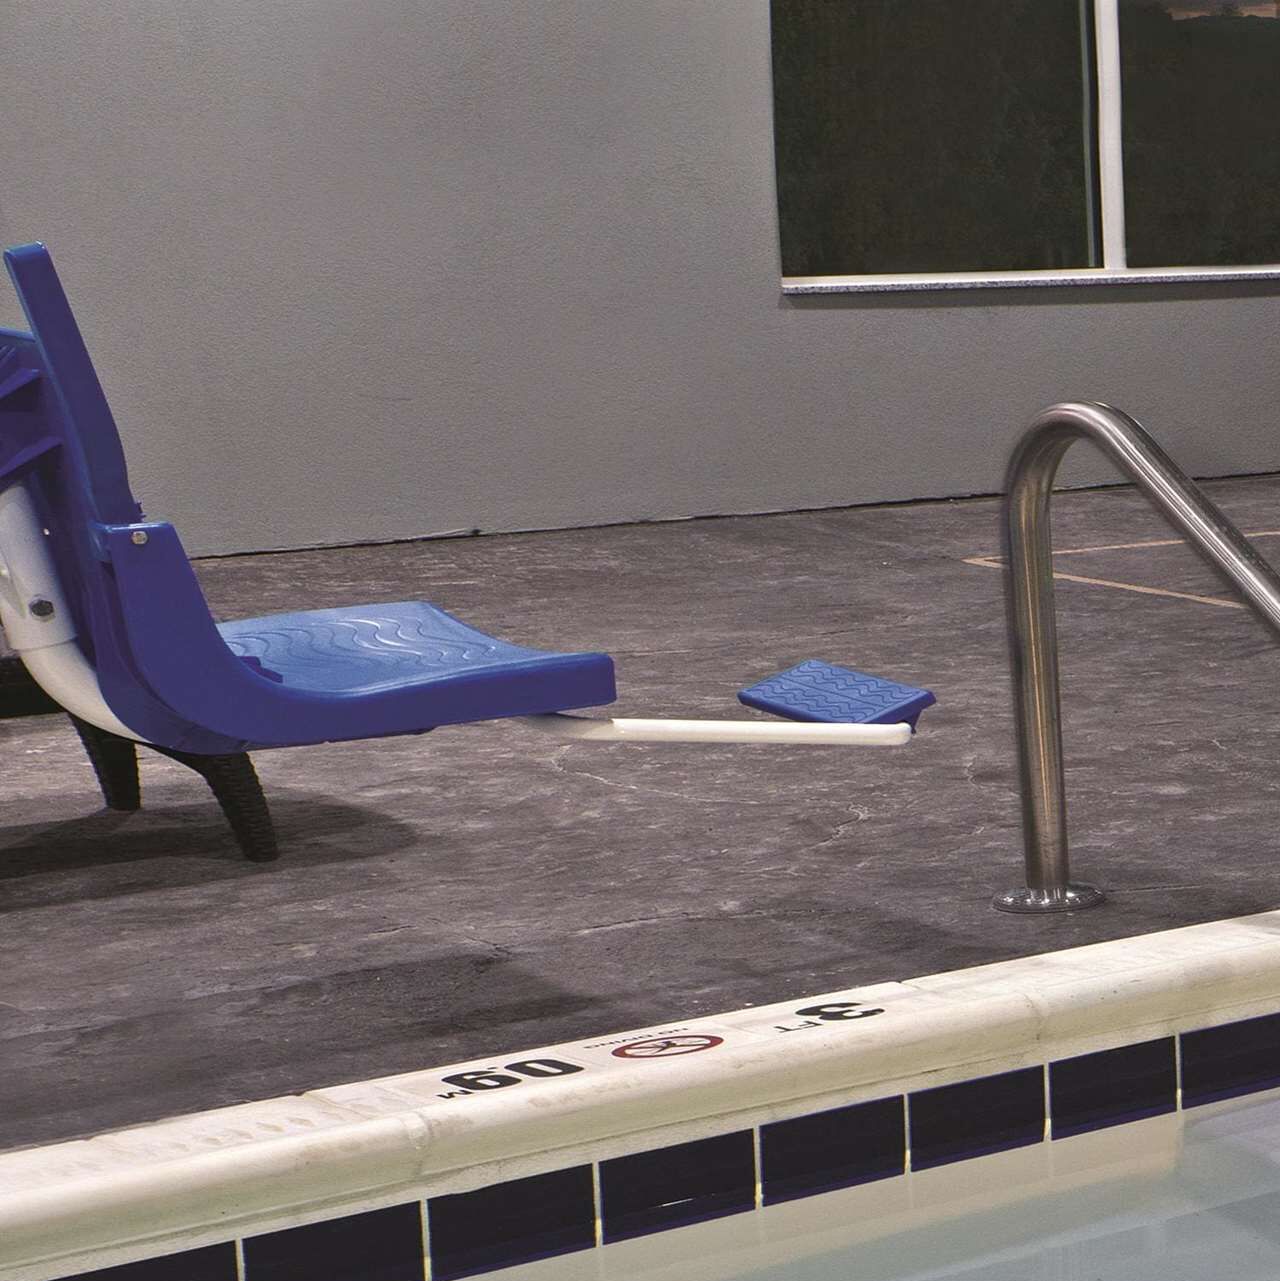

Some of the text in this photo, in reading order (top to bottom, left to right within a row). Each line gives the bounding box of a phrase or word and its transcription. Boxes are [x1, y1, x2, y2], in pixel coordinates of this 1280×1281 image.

[773, 1002, 886, 1034] 3 FT
[436, 1059, 585, 1101] 0.9 M
